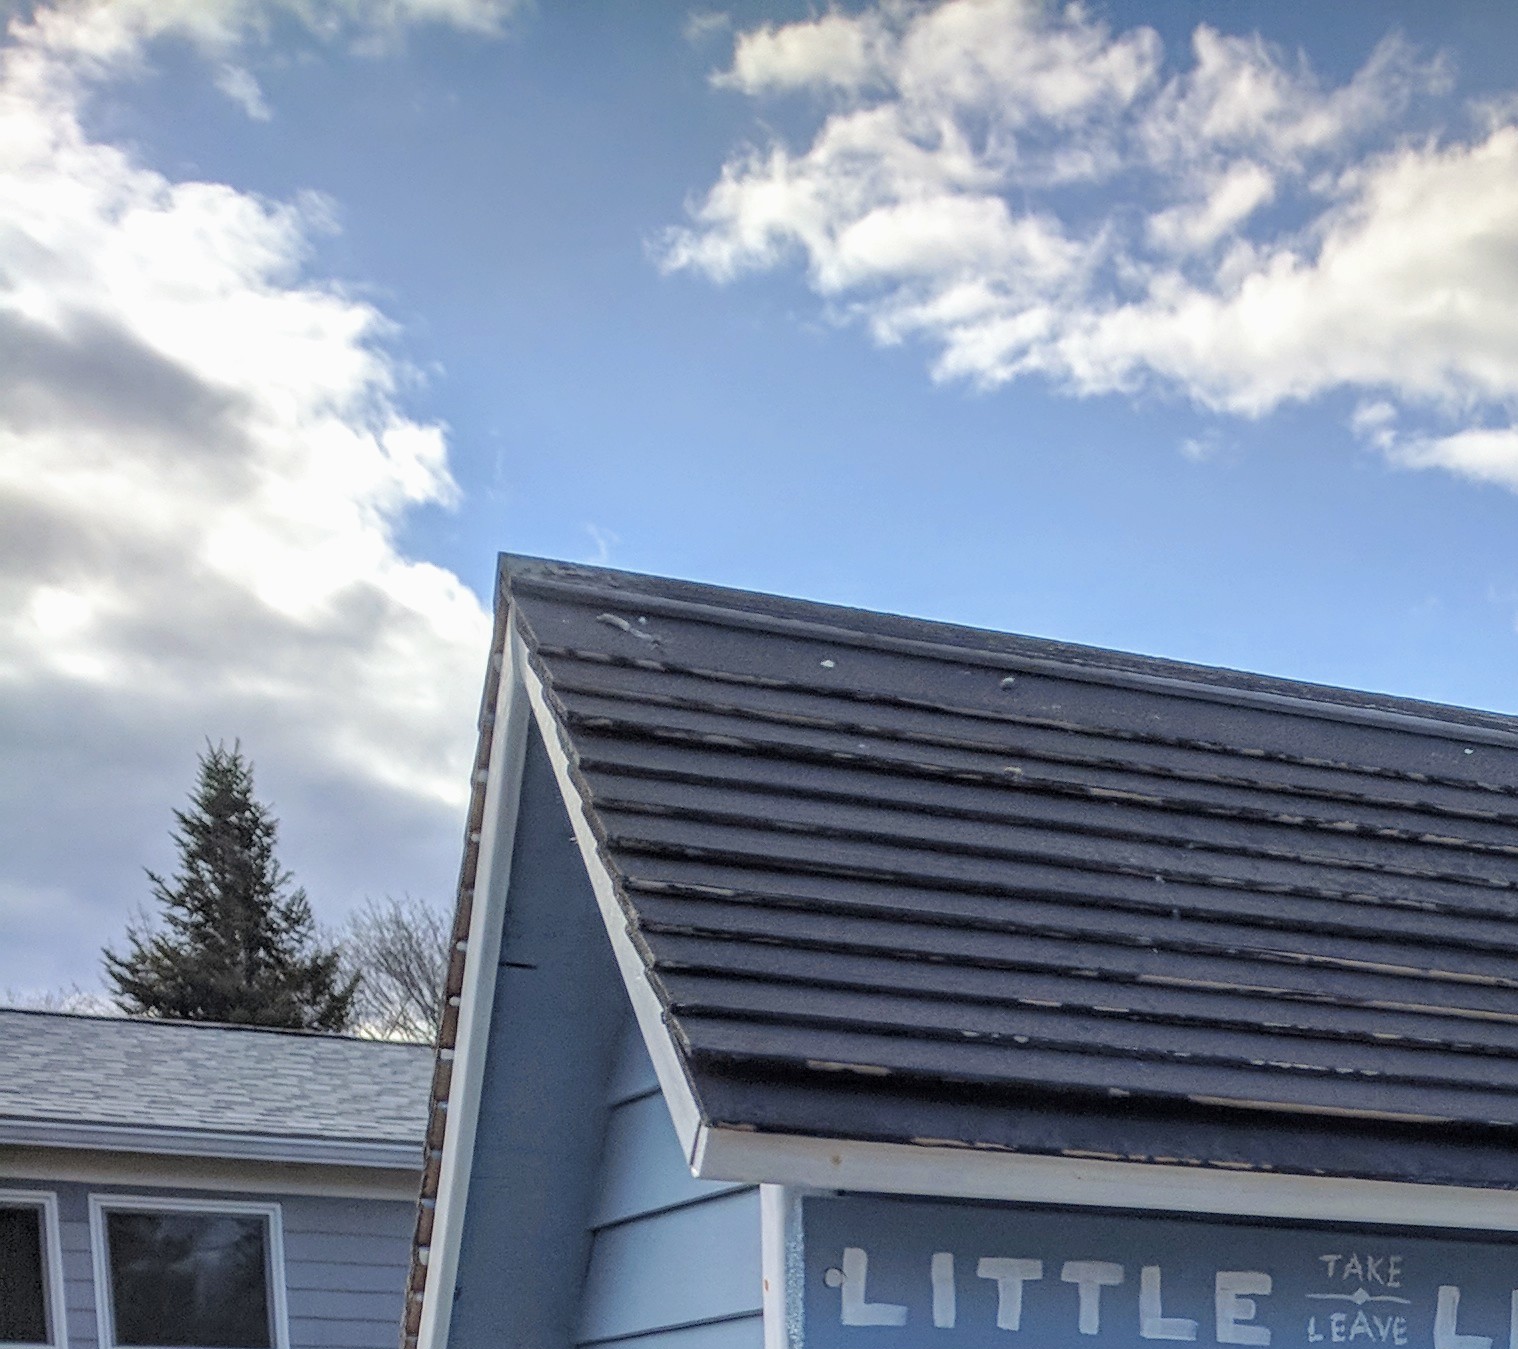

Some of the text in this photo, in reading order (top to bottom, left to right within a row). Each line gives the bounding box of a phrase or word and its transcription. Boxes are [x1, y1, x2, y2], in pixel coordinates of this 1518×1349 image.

[1319, 1253, 1403, 1288] TAKE
[840, 1247, 1273, 1347] LITTLE
[1307, 1310, 1408, 1346] LEAVE
